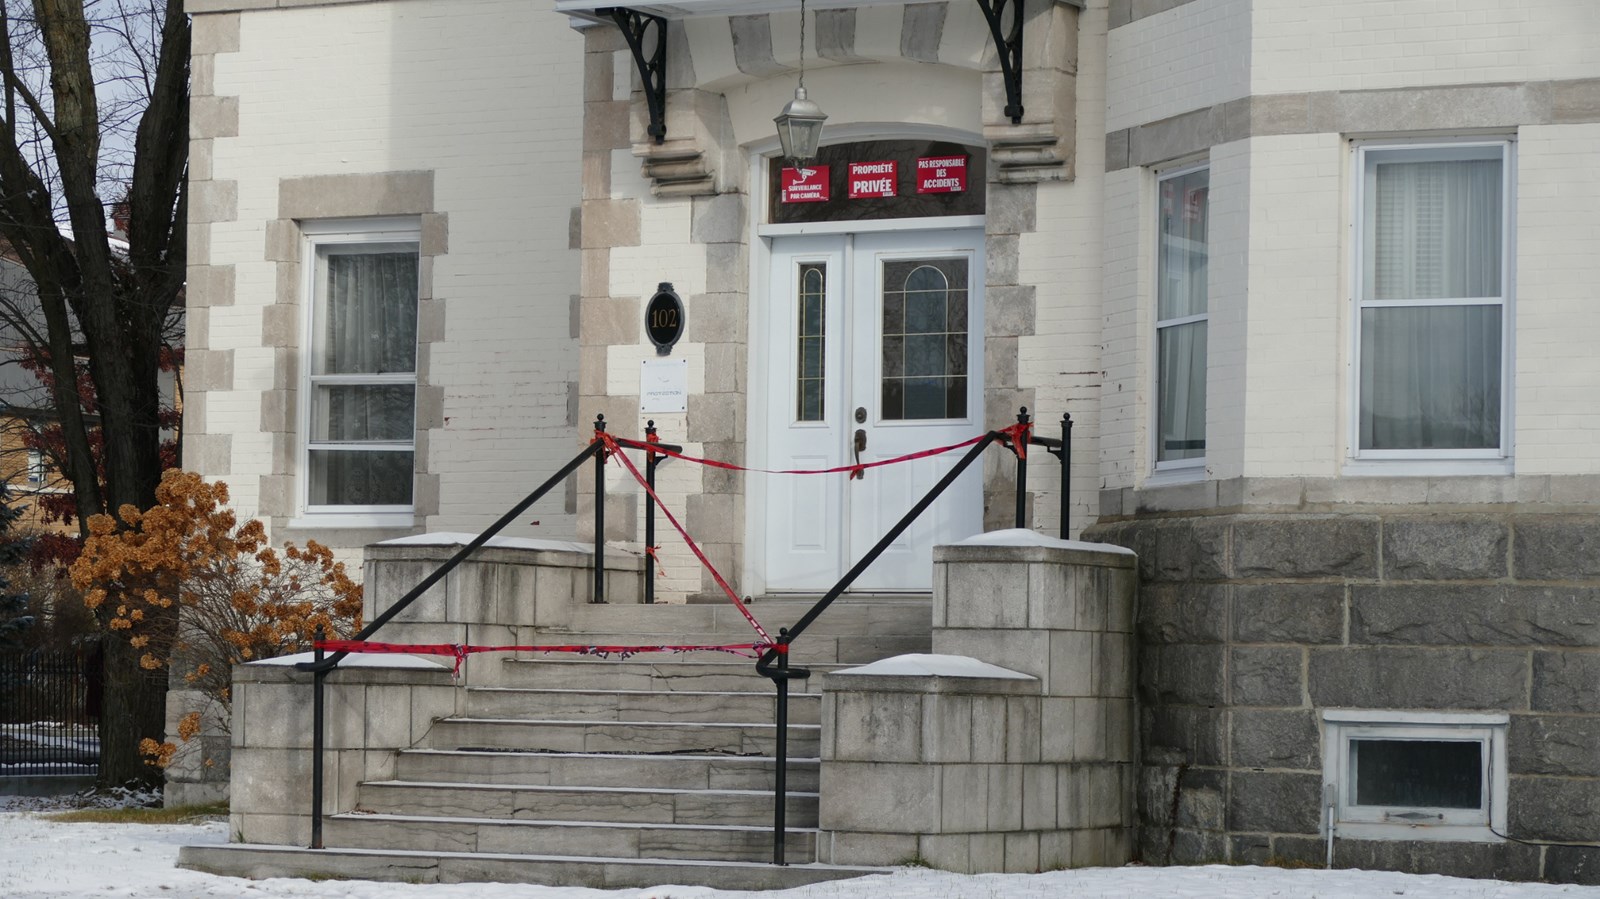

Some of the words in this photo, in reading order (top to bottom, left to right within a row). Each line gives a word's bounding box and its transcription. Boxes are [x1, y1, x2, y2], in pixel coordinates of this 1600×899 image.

[852, 162, 893, 175] PROPRIÉTÉ
[918, 160, 929, 168] PAS
[929, 158, 965, 168] RESPONSABLE
[936, 168, 947, 177] DES
[853, 177, 892, 193] PRIVÉE
[923, 178, 959, 189] ACCIDENTS
[651, 308, 677, 328] 102
